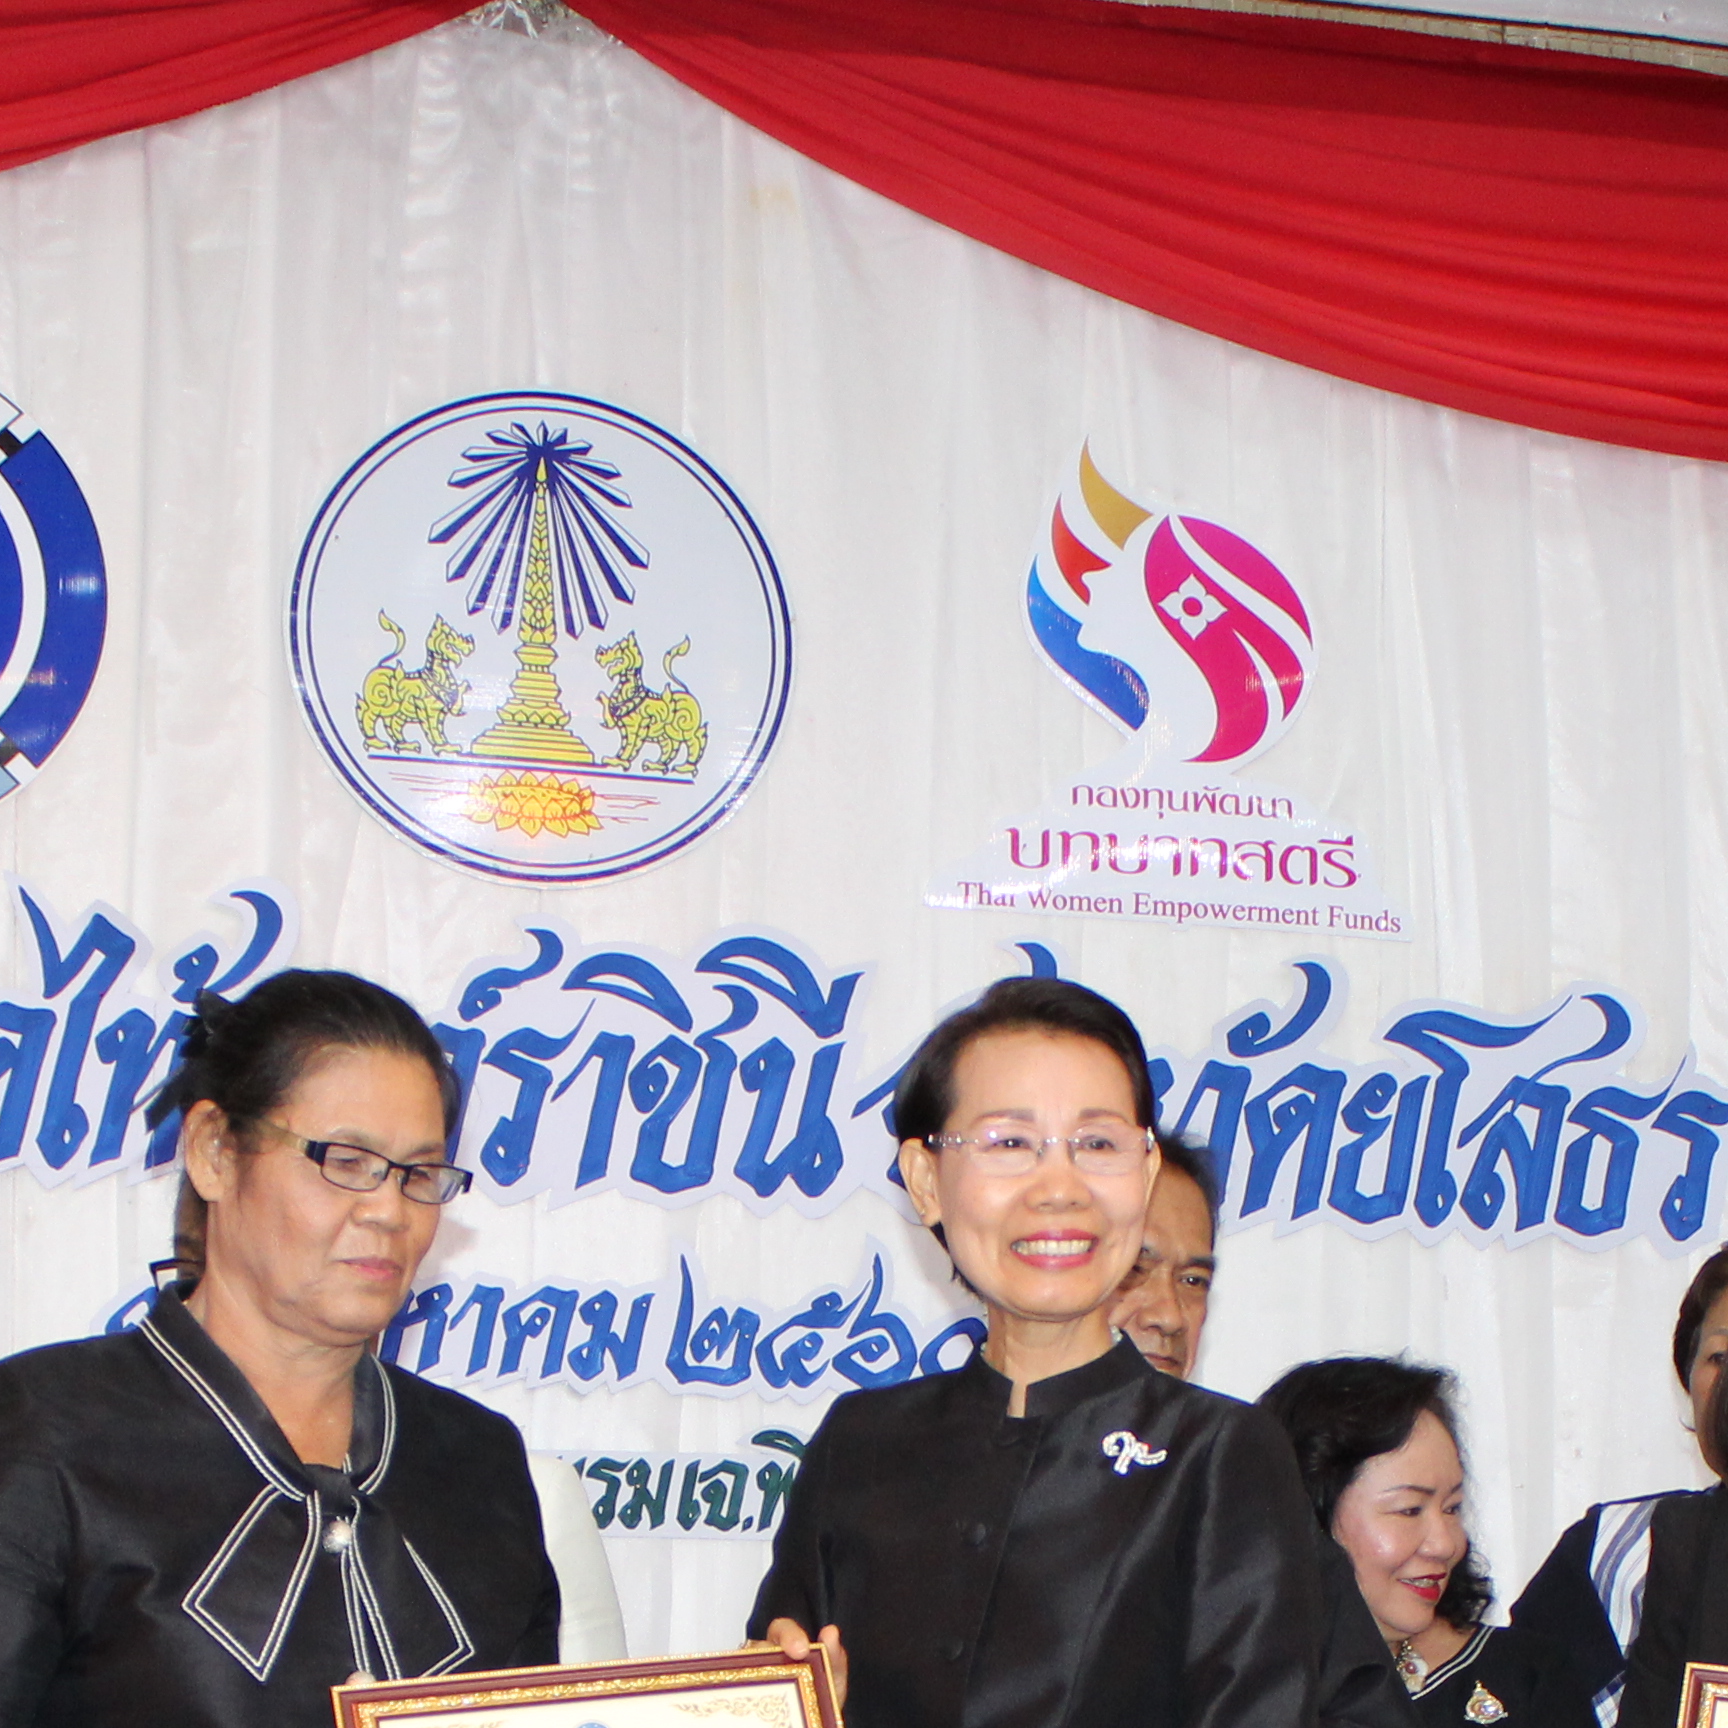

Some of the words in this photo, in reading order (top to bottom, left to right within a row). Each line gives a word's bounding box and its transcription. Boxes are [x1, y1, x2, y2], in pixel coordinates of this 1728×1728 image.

[1071, 784, 1294, 820] กองทุนพัฒนา
[957, 881, 1016, 907] Thai
[1027, 888, 1124, 915] Women
[1131, 892, 1320, 927] Empowerment
[1327, 905, 1402, 933] Funds
